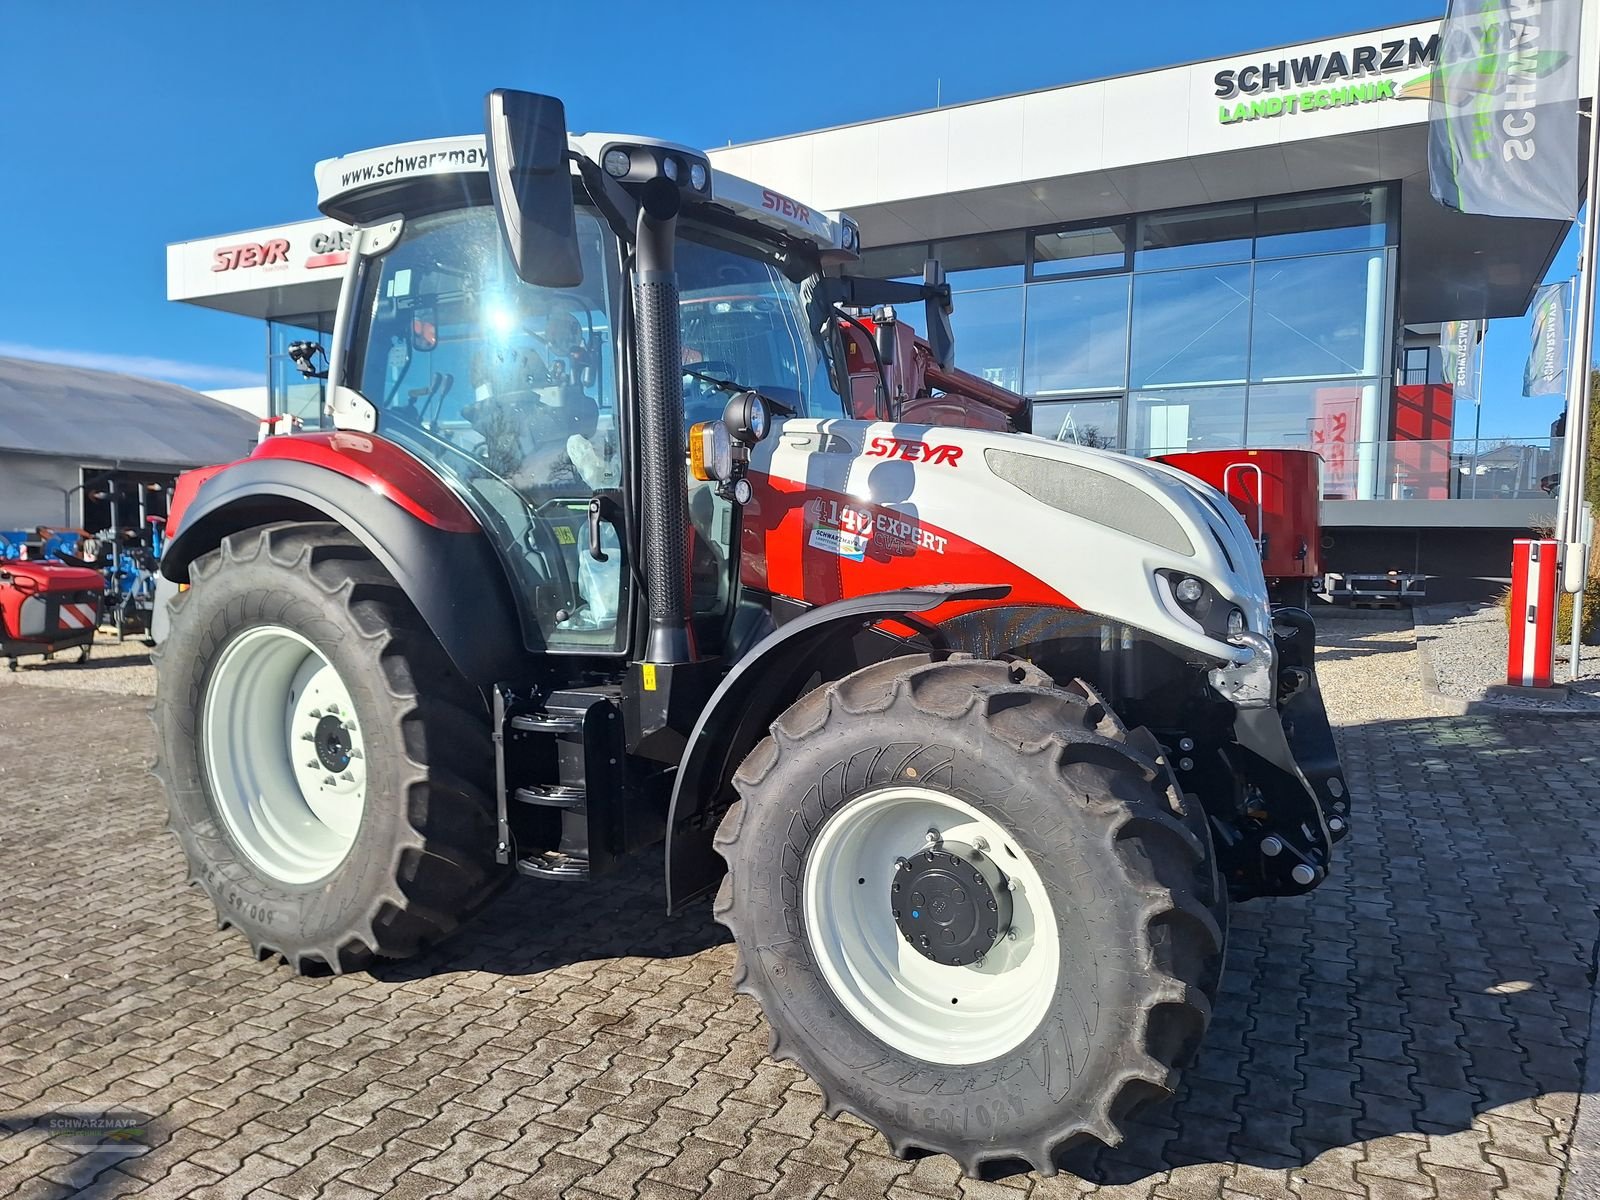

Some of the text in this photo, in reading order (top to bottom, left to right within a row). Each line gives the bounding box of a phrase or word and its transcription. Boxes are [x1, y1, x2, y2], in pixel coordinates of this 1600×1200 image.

[1218, 79, 1395, 124] LANDTECHNIK
[762, 190, 810, 224] STEYR
[211, 238, 290, 272] STEYR
[310, 227, 354, 254] CAS
[866, 437, 963, 468] STEYR
[811, 496, 948, 555] 4140 EXPERT
[873, 531, 905, 554] CVT
[227, 892, 274, 925] 600/65
